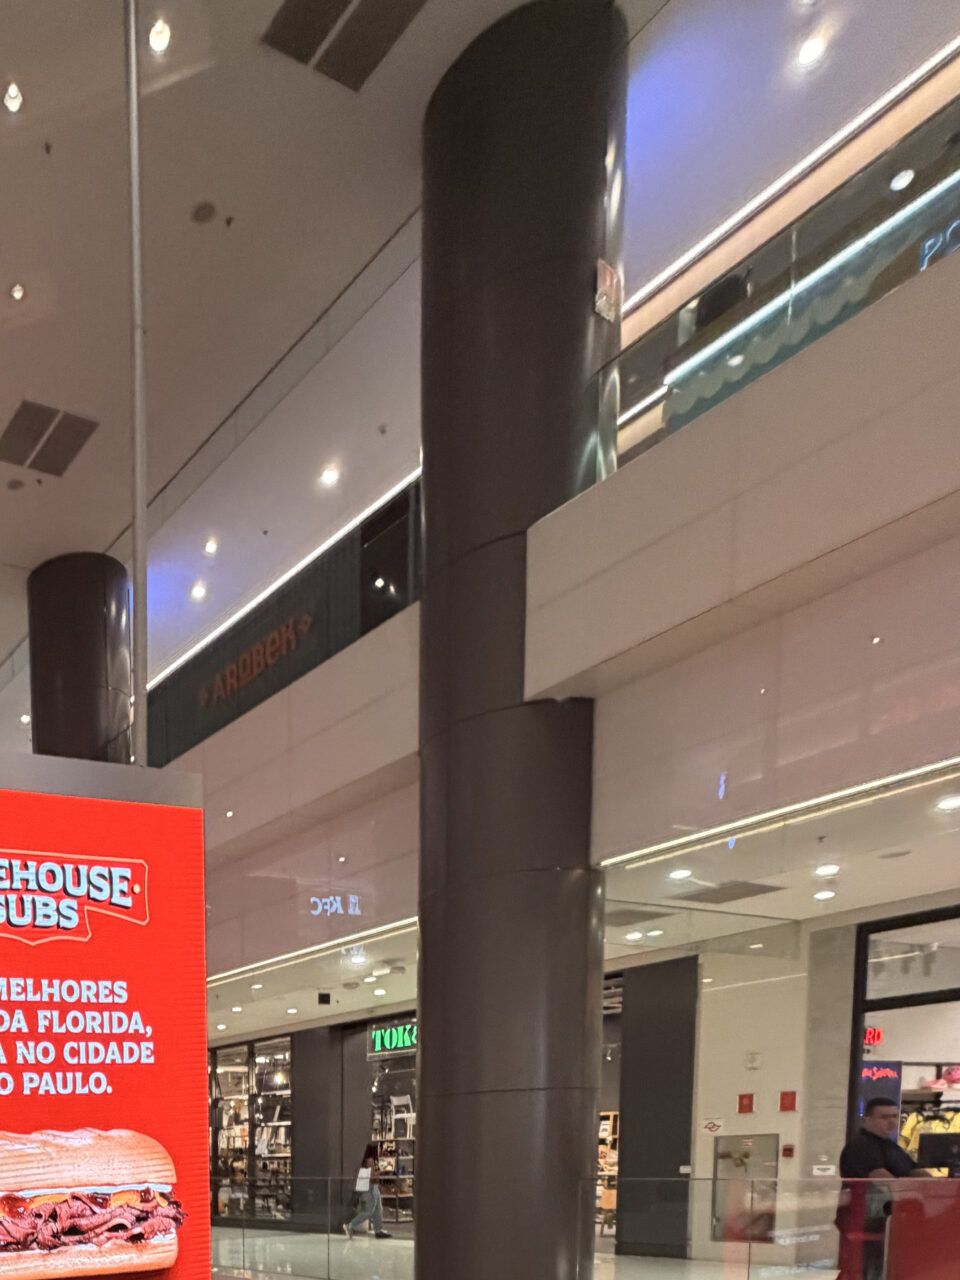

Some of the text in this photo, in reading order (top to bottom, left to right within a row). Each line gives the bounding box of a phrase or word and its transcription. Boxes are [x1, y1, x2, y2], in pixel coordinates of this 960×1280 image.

[37, 1010, 153, 1038] FLORIDA,
[863, 1027, 884, 1045] RD
[16, 1041, 56, 1065] NO
[63, 1041, 155, 1065] CIDADE
[23, 1072, 113, 1096] PAULO.
